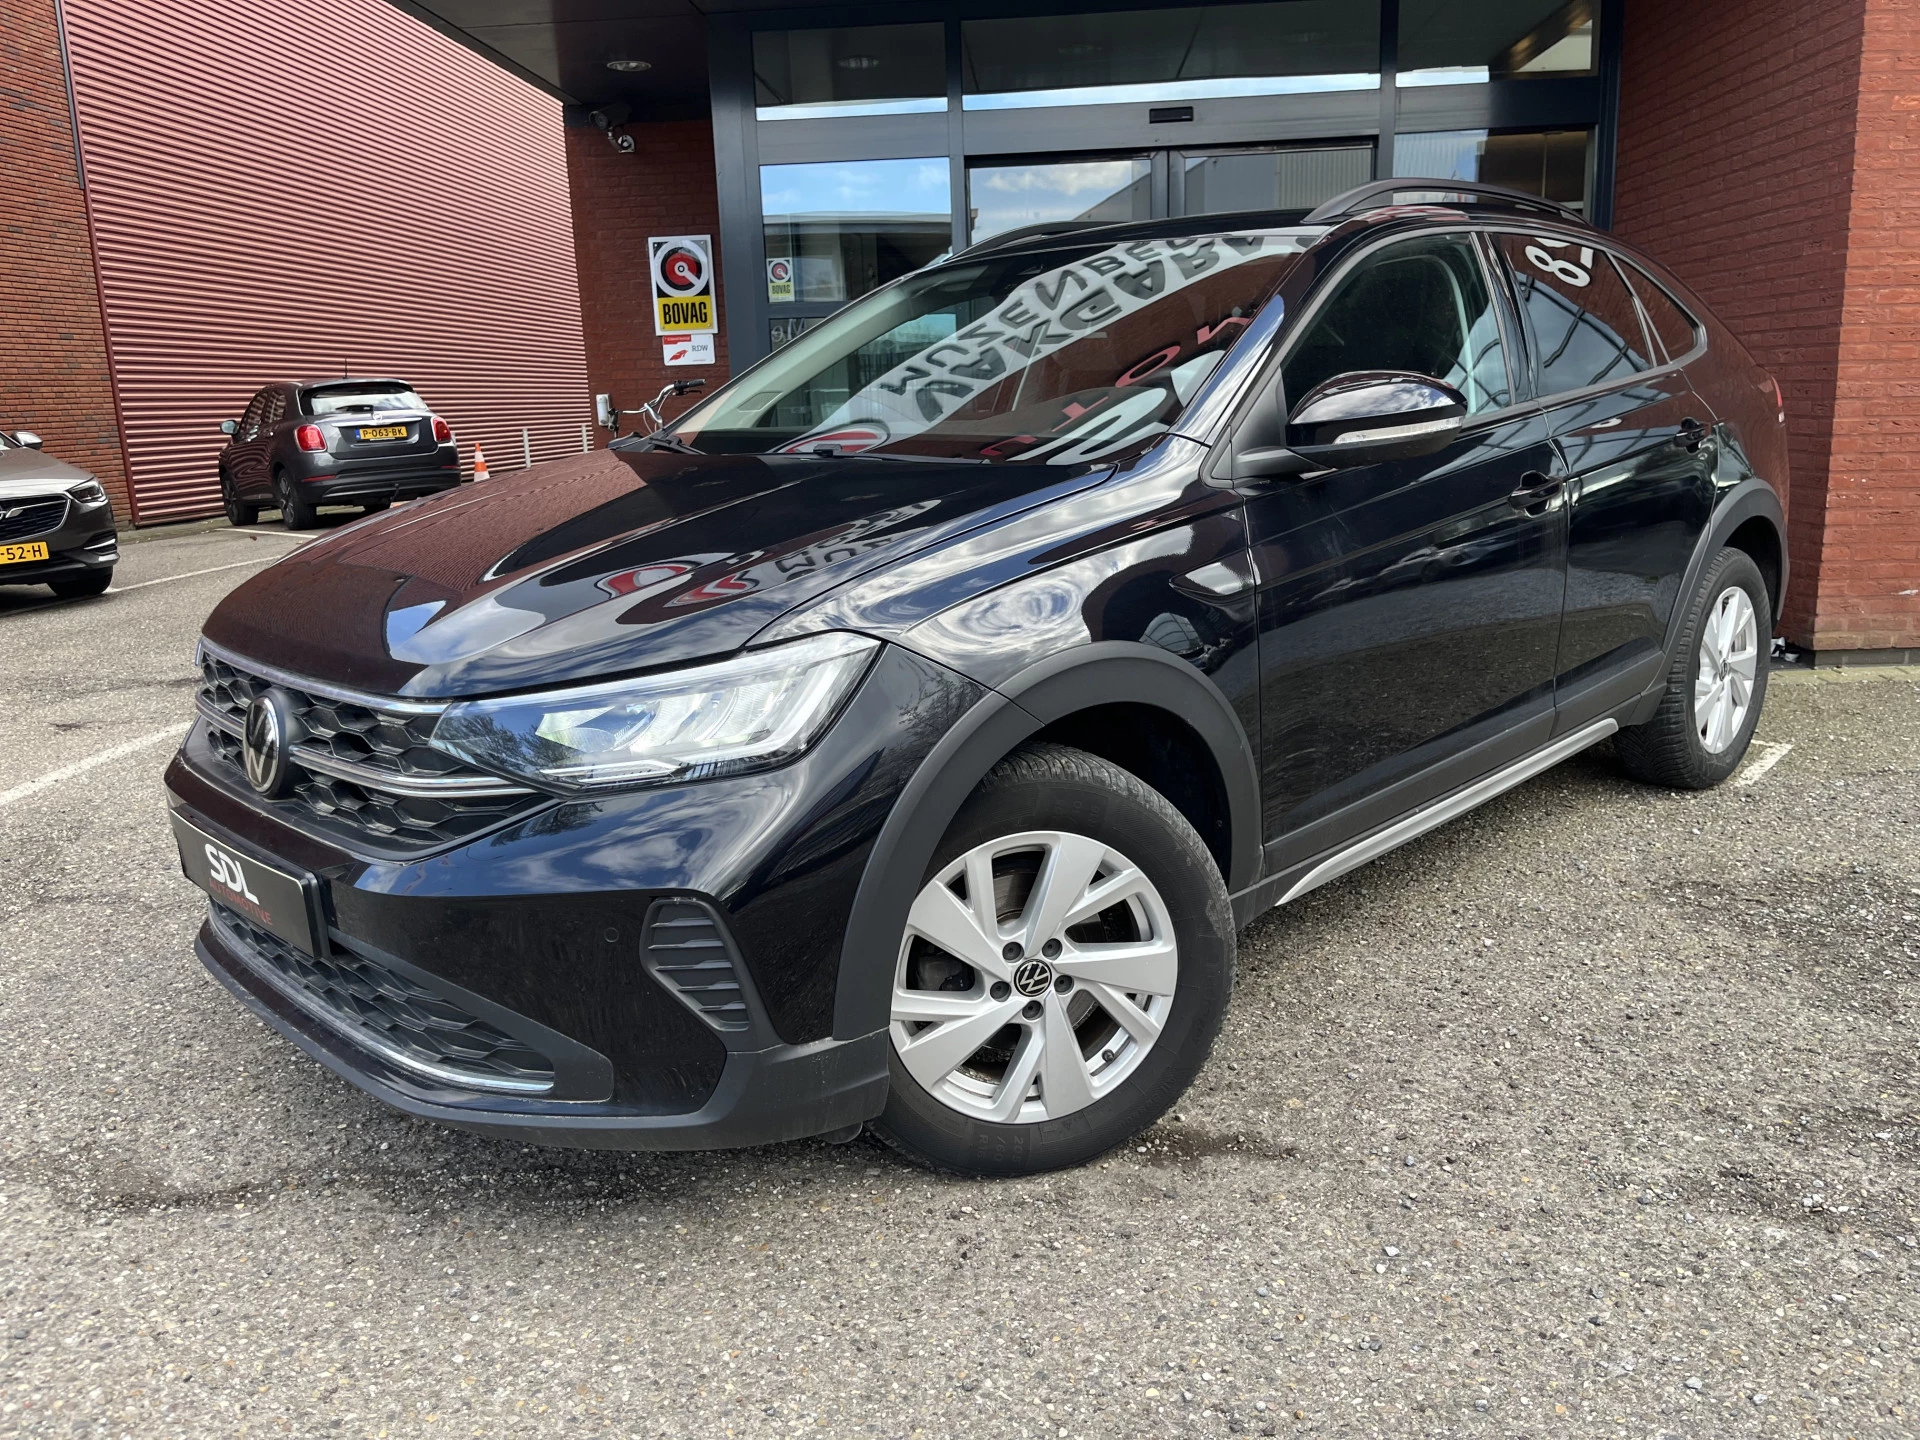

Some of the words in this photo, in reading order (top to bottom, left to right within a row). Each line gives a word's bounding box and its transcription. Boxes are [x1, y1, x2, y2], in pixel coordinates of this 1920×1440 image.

[771, 284, 791, 295] BOVAG
[662, 301, 708, 325] BOVAG
[691, 344, 709, 352] RDW
[362, 427, 404, 437] P-063-BK
[204, 843, 260, 906] SDL
[209, 876, 274, 926] AUTOMOTIVE
